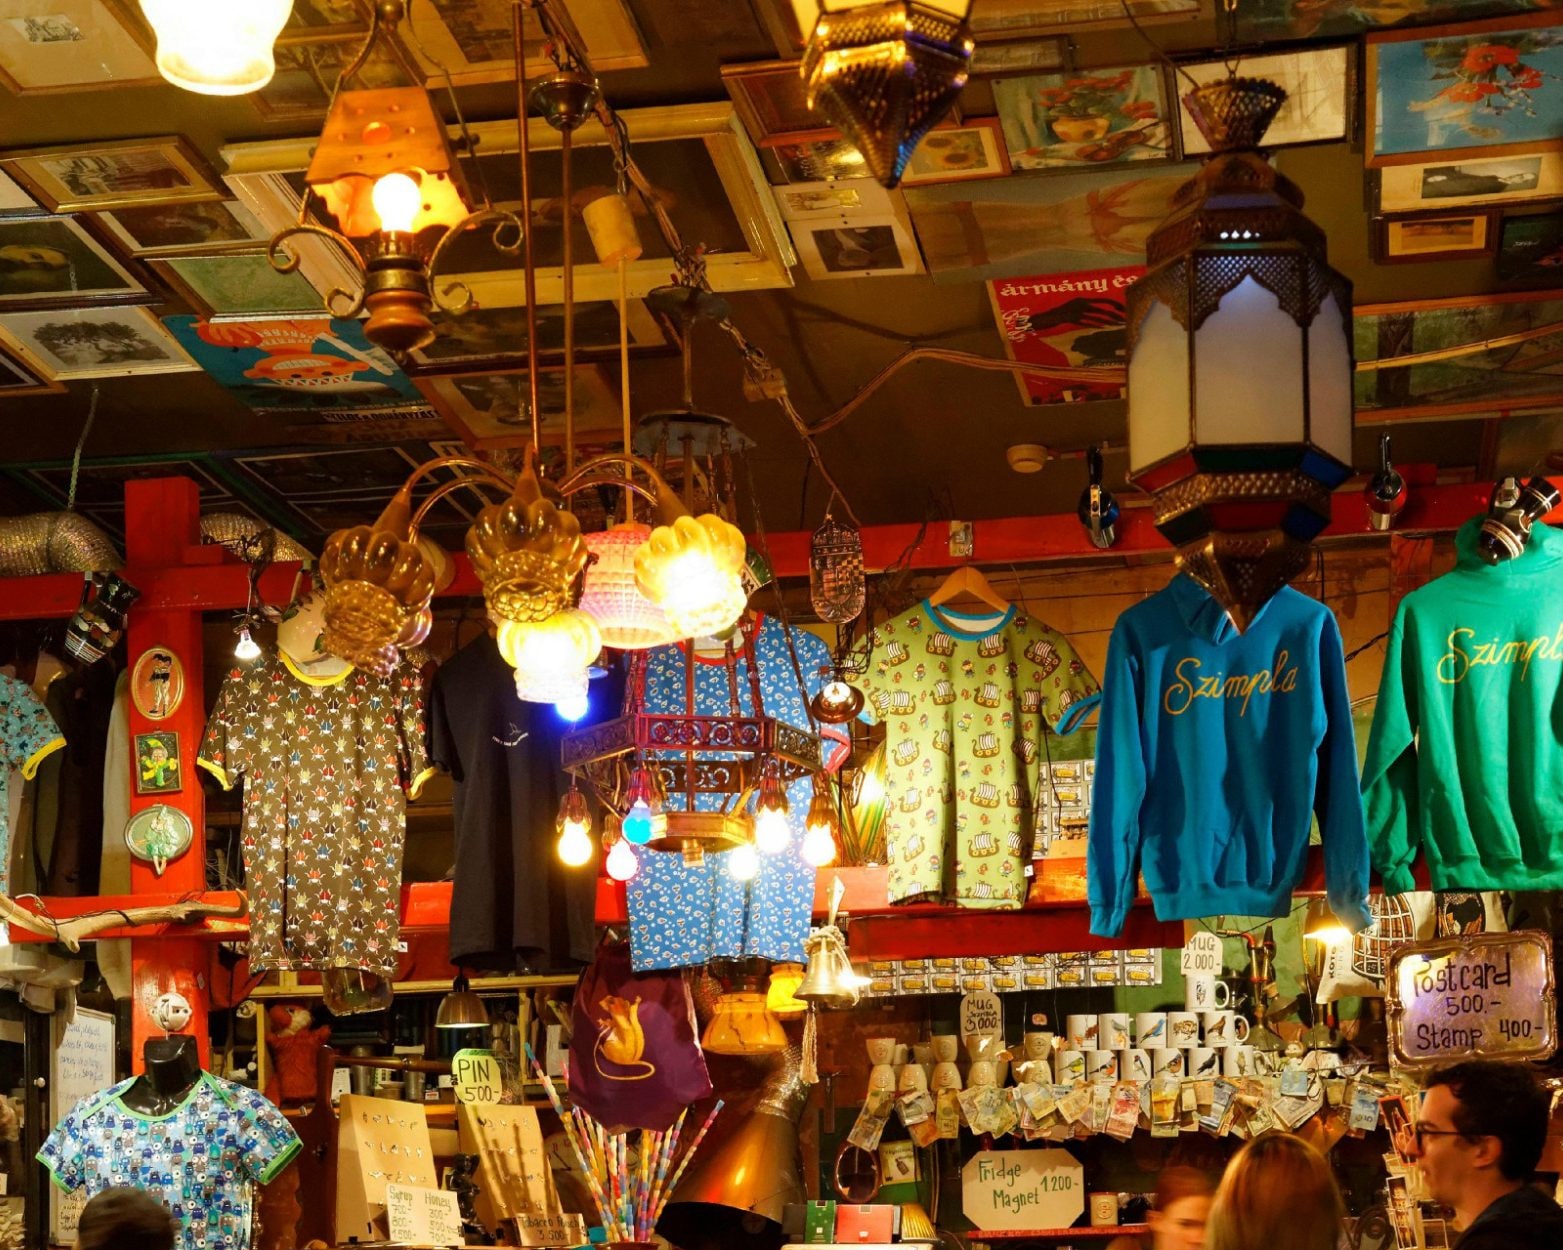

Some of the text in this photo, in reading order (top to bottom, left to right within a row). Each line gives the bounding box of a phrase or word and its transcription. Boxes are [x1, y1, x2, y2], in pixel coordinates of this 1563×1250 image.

[1000, 277, 1108, 297] ármány
[1164, 650, 1298, 717] Szimpla
[1186, 936, 1216, 951] MUG
[1413, 952, 1511, 998] Postcard
[967, 999, 993, 1011] MUG
[1416, 1023, 1483, 1050] Stamp
[458, 1059, 490, 1082] PIN
[978, 1157, 1021, 1187] Fridge
[389, 1185, 452, 1212] Syrup Honey
[992, 1187, 1040, 1214] Magnet
